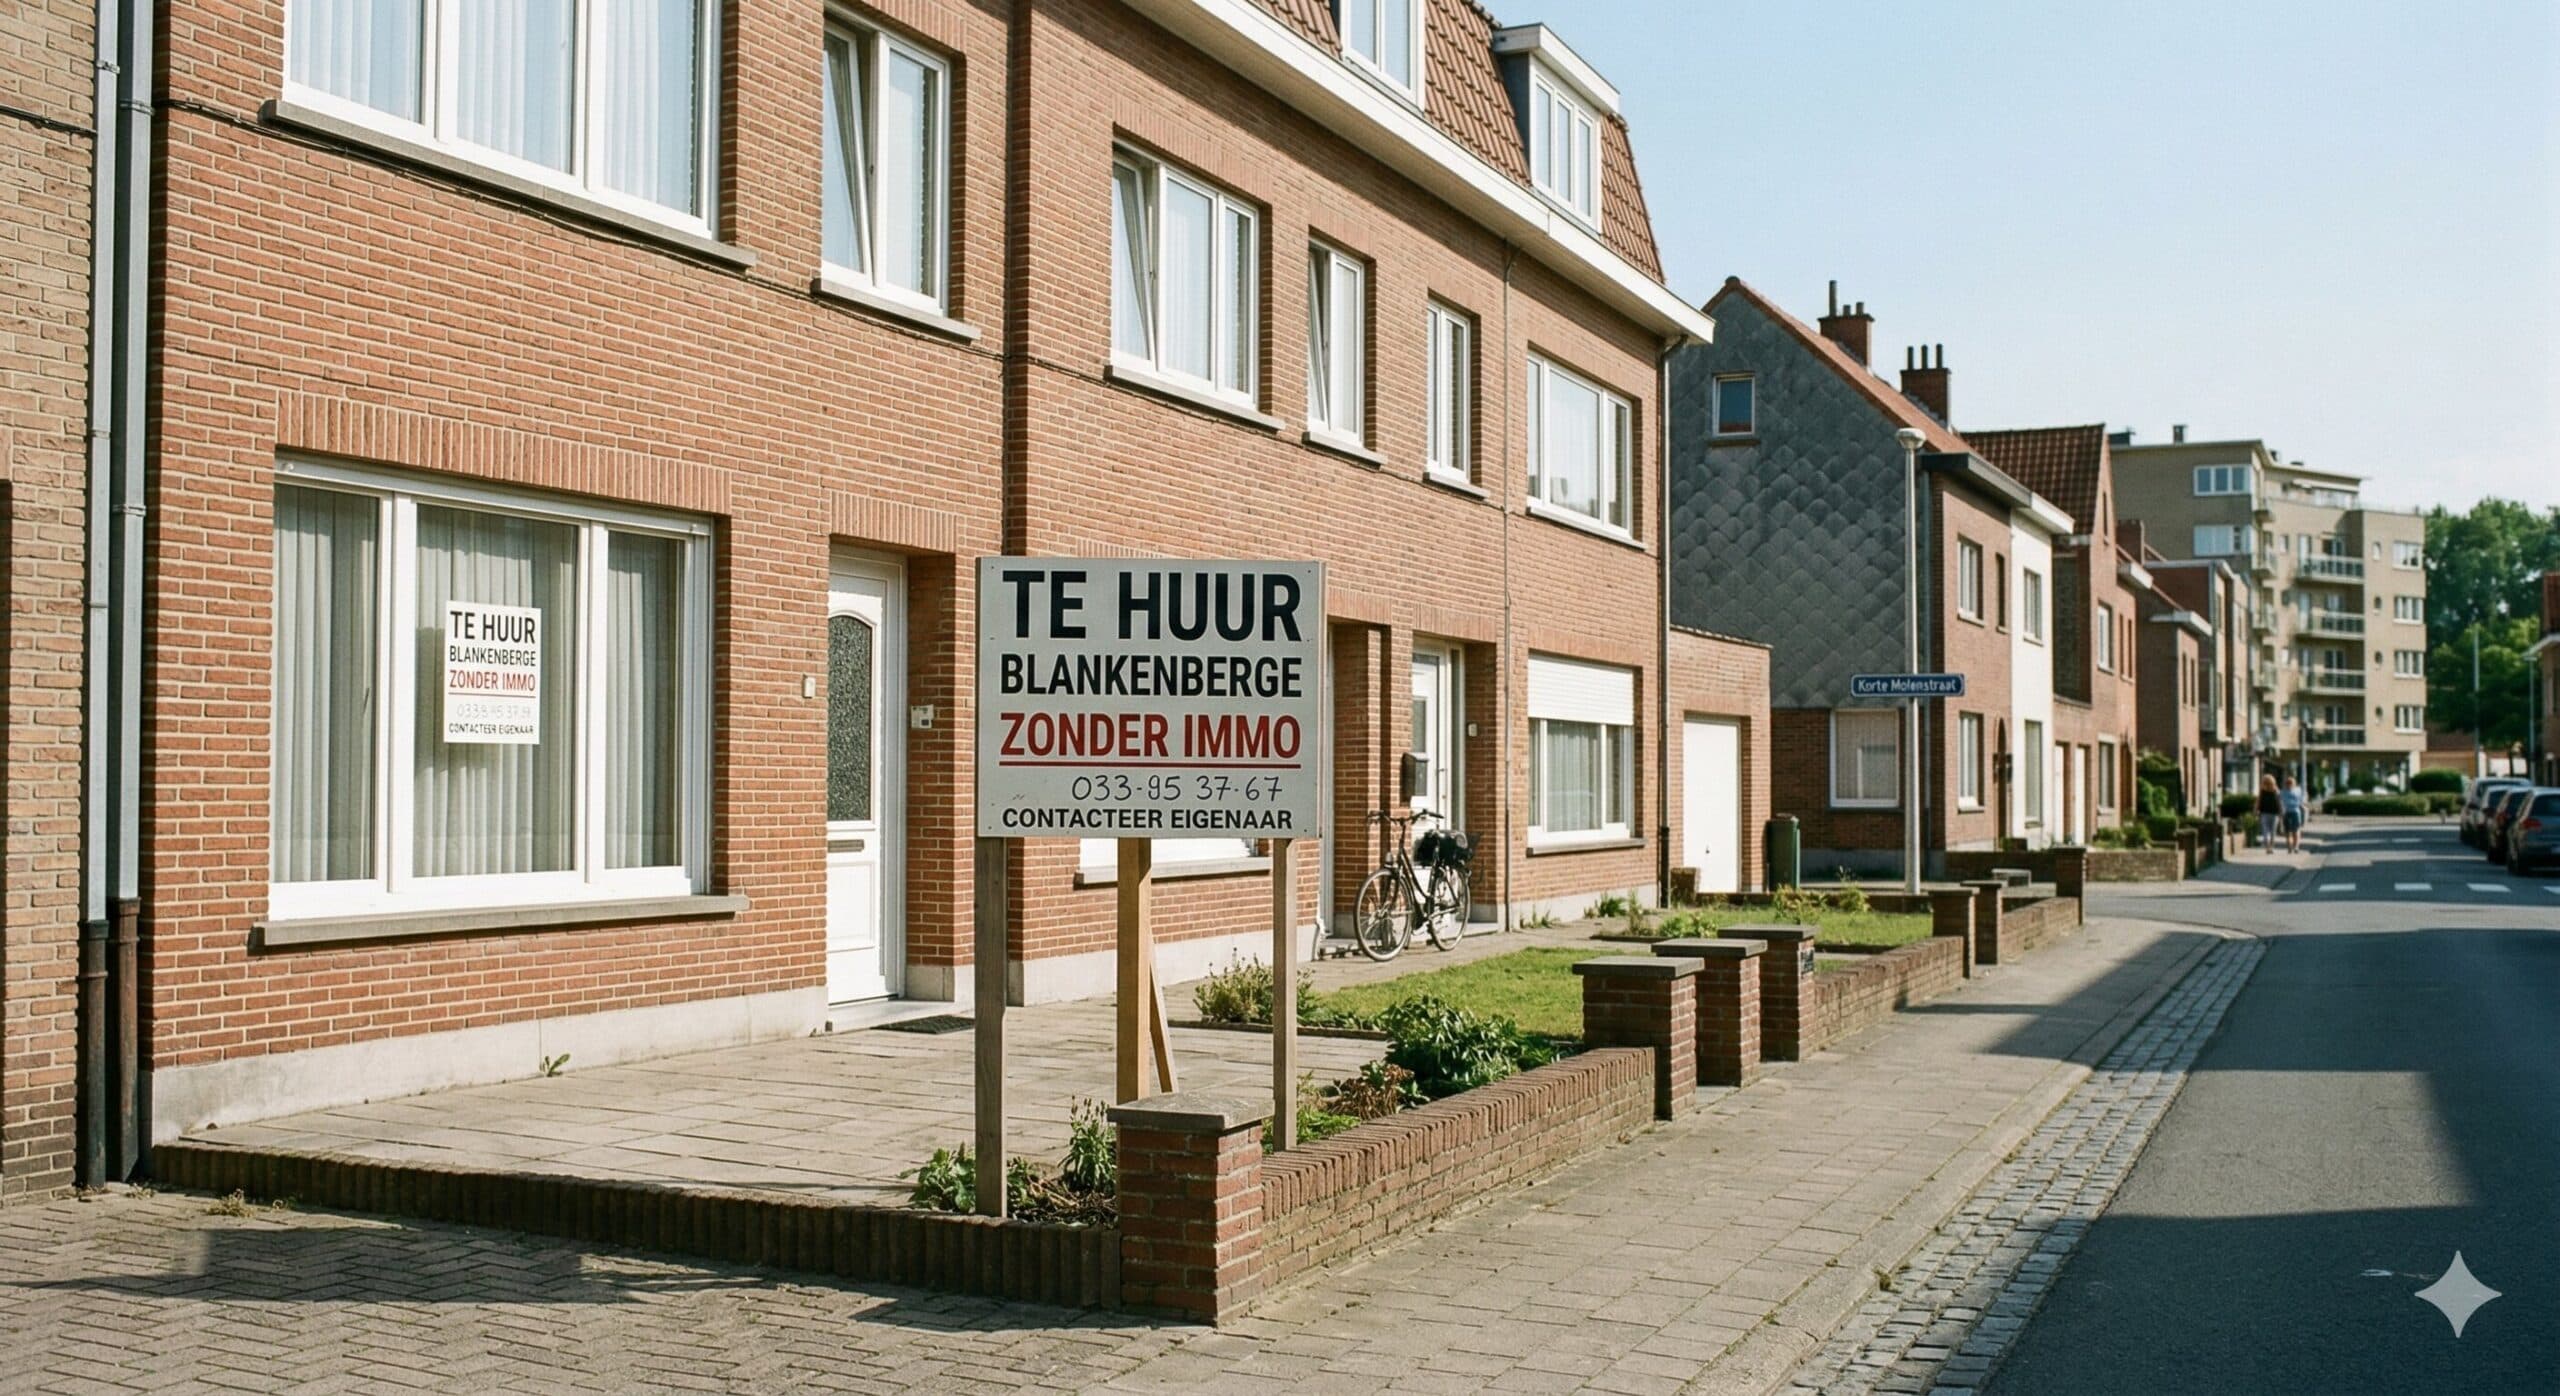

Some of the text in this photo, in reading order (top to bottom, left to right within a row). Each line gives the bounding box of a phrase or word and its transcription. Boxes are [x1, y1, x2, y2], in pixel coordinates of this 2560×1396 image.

[1002, 570, 1302, 642] TE HUUR
[450, 611, 536, 644] TE HUUR
[450, 645, 536, 667] BLANKENBERGE
[449, 669, 536, 691] ZONDER IMMO
[1001, 654, 1302, 698] BLANKENBERGE
[1858, 679, 1956, 692] Korte Molenstraat
[1000, 712, 1301, 759] ZONDER IMMO
[1002, 807, 1293, 830] CONTACTEER EIGENAAR
